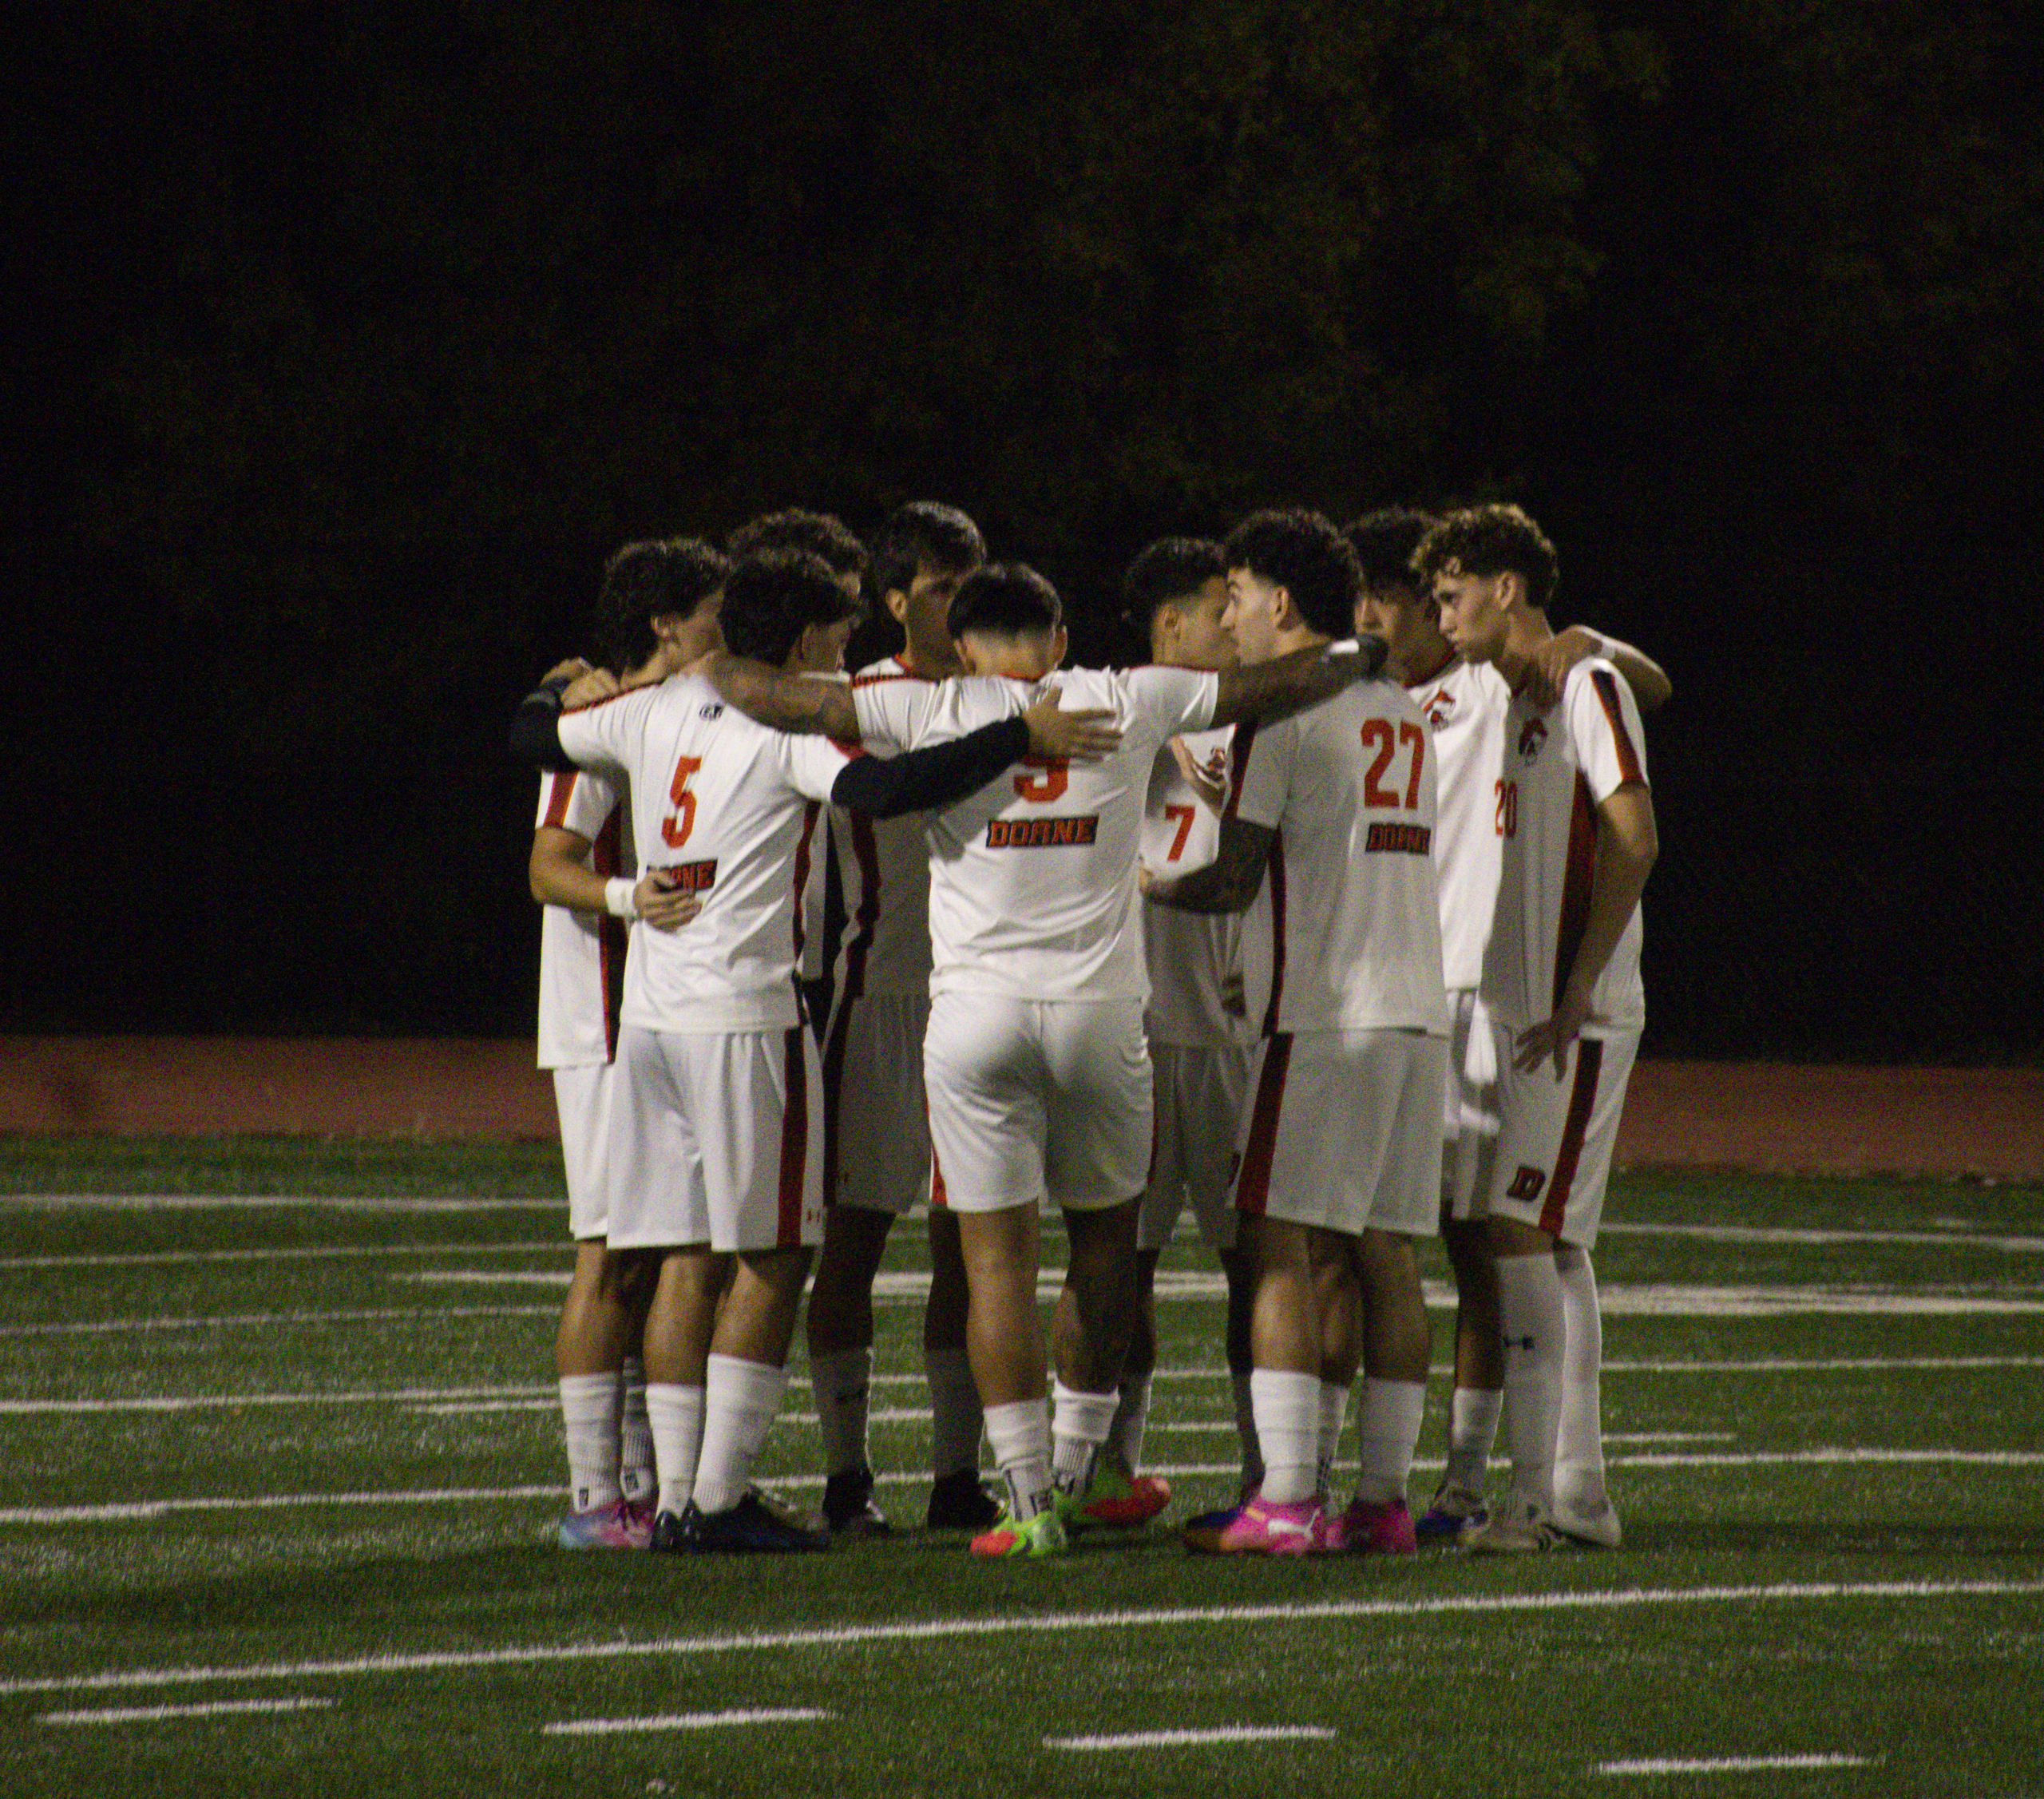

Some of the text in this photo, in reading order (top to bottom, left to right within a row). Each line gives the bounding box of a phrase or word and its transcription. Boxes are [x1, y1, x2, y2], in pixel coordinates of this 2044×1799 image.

[1361, 719, 1424, 810] 27
[661, 755, 702, 849] 5
[988, 816, 1097, 847] DOANE
[1495, 778, 1517, 838] 20
[1166, 805, 1195, 862] 7
